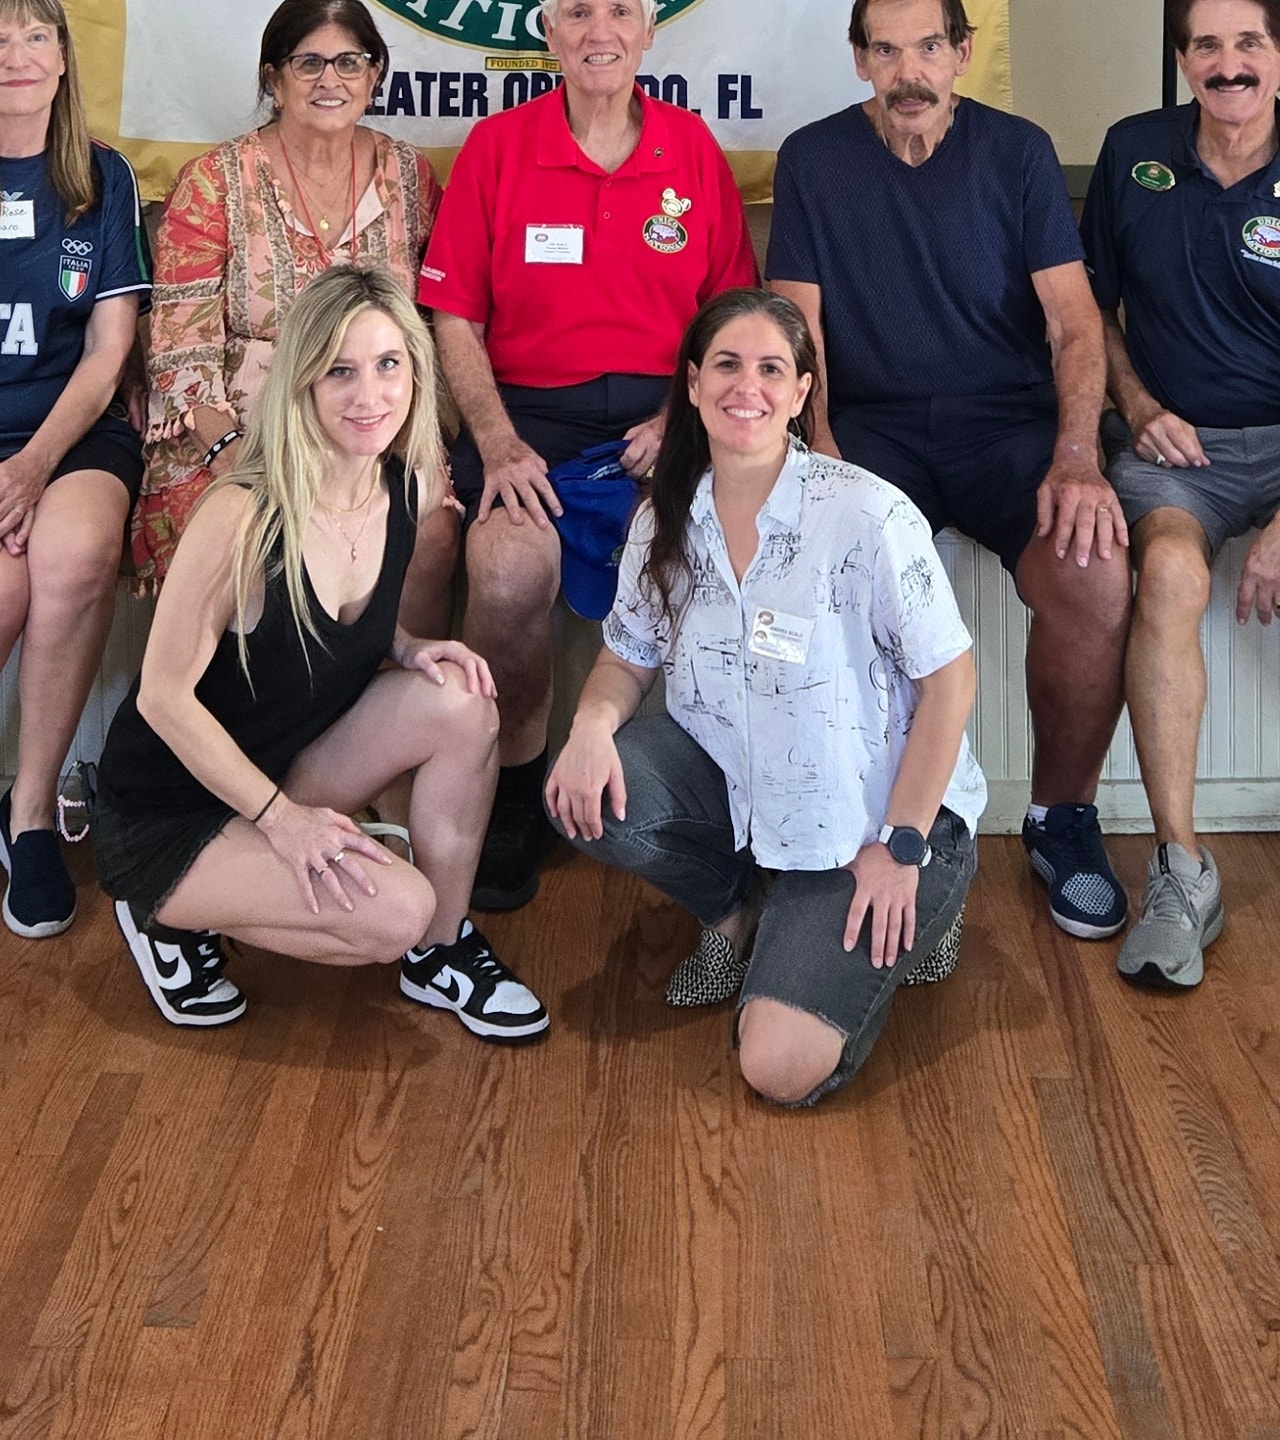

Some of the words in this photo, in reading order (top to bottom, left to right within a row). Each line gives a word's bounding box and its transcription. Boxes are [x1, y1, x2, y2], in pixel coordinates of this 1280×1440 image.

[489, 58, 539, 69] FOUNDED
[717, 73, 763, 119] FL
[63, 258, 89, 268] ITALIA
